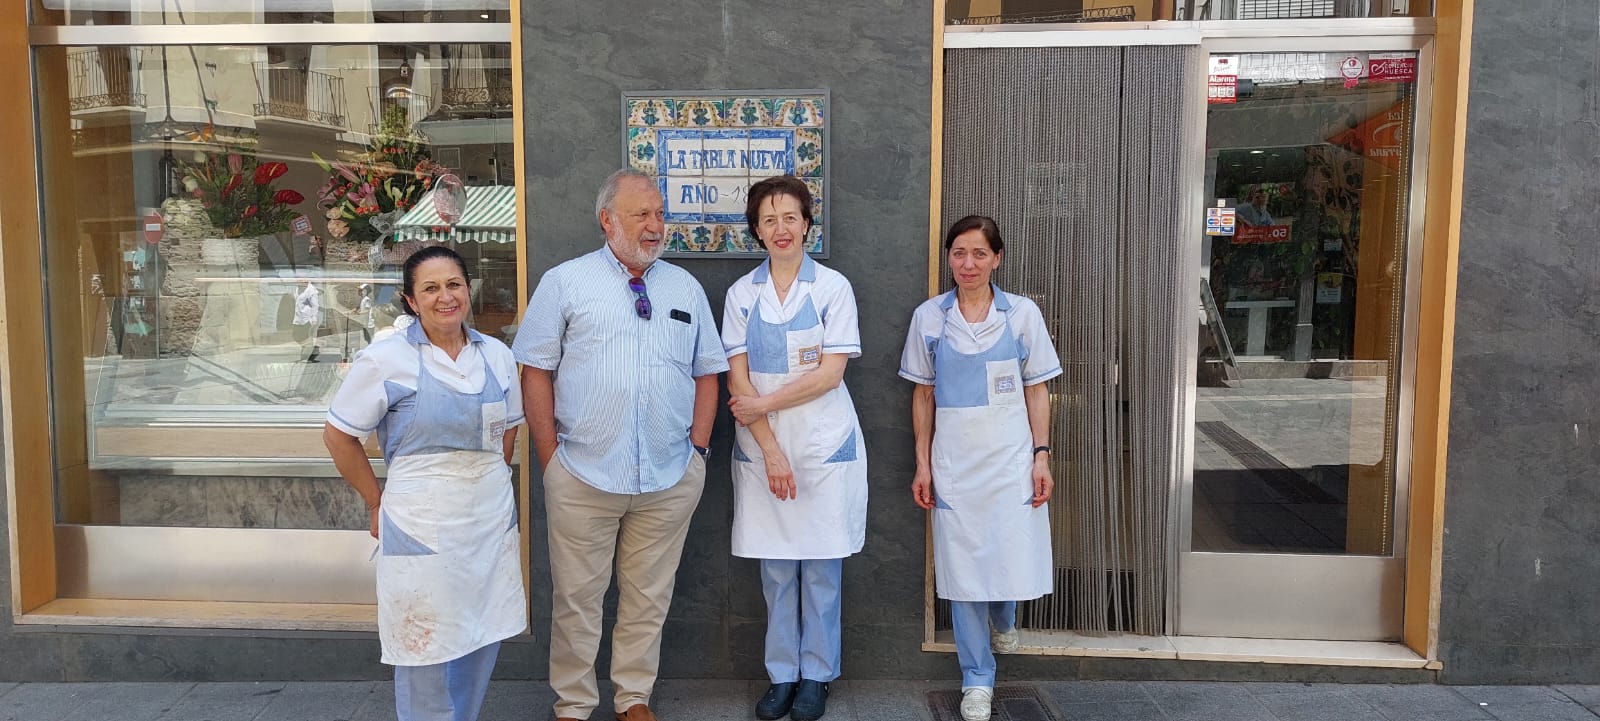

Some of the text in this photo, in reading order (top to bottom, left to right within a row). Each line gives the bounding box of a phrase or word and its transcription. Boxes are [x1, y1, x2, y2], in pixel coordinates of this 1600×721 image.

[1209, 75, 1236, 83] Alarma
[668, 149, 786, 170] LA TABLA NUEVA
[680, 182, 719, 204] AÑO
